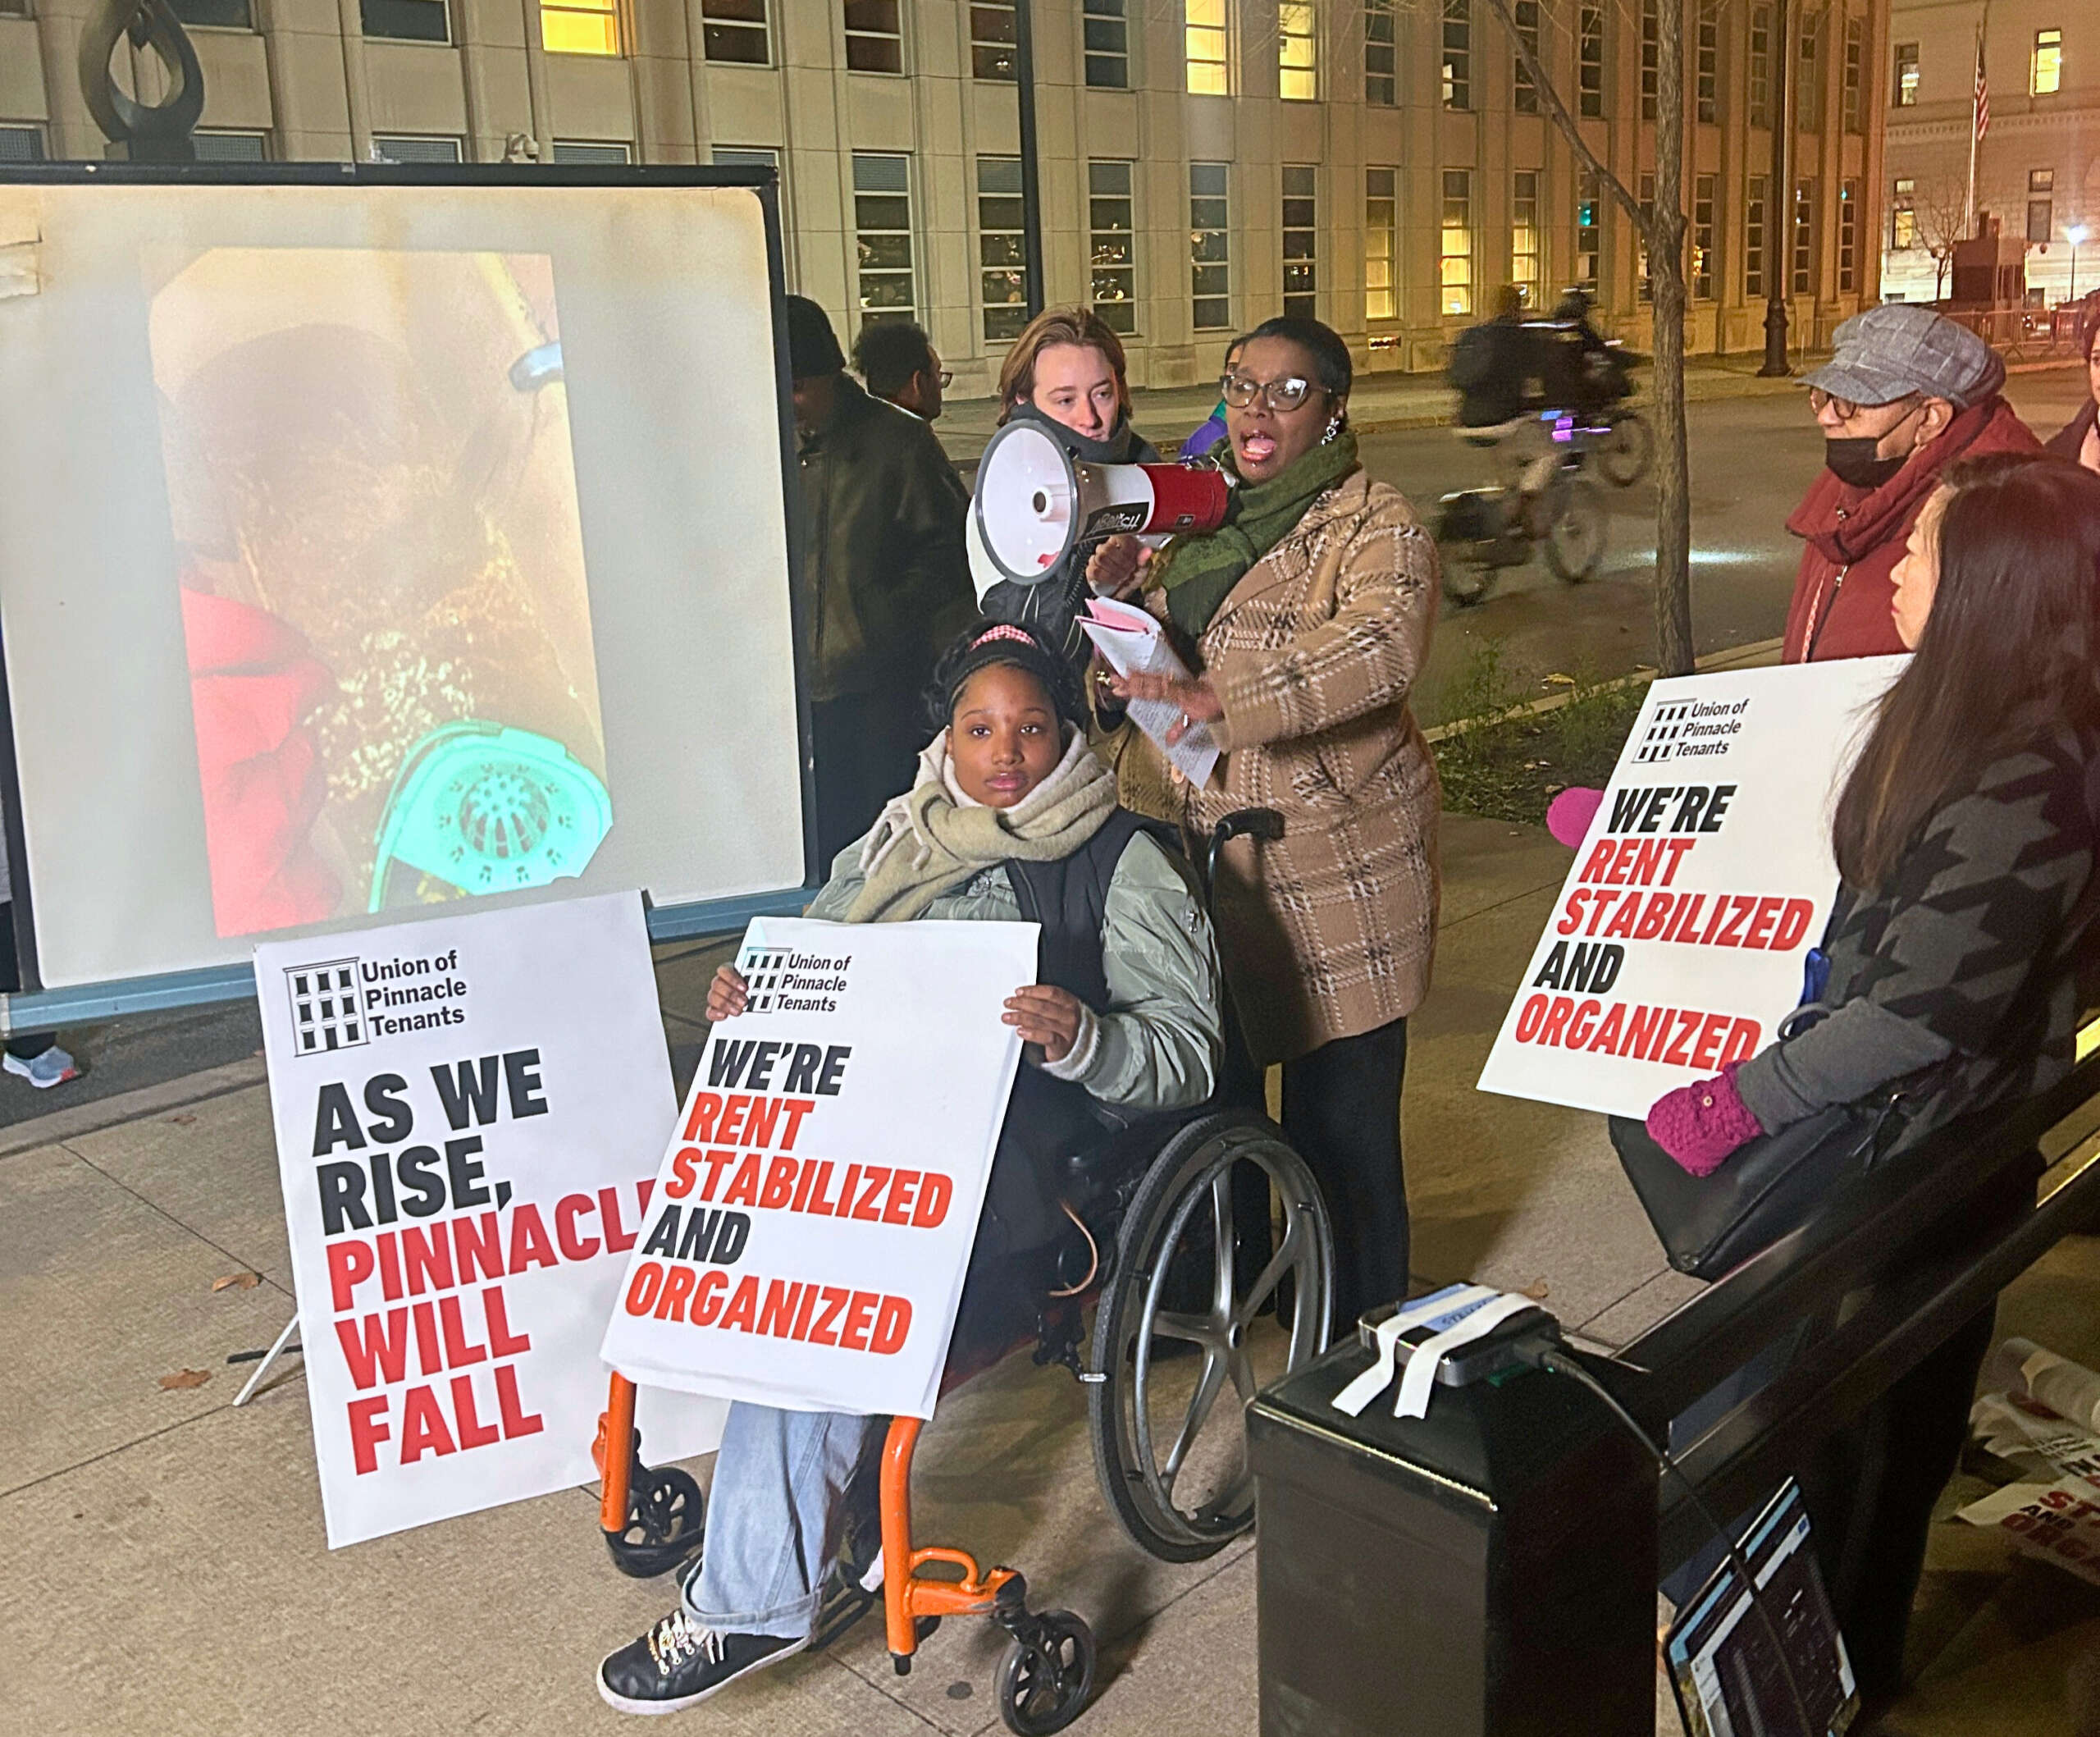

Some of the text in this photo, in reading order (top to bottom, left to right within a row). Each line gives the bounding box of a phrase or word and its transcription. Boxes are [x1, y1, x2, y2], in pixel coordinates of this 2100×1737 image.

[1682, 719, 1741, 737] Pinnacle
[1691, 698, 1749, 717] Union of
[1677, 740, 1728, 757] Tenants
[1608, 785, 1737, 834] WE'RE
[1578, 839, 1695, 886] RENT
[1557, 889, 1813, 951] STABILIZED
[362, 949, 457, 983] Union of
[782, 975, 846, 991] Pinnacle
[789, 953, 851, 971] Union of
[1532, 941, 1624, 994] AND
[366, 978, 466, 1009] Pinnacle
[369, 1006, 464, 1036] Tenants
[777, 994, 836, 1012] Tenants
[1516, 994, 1761, 1072] ORGANIZED
[707, 1039, 851, 1096] WE'RE
[313, 1049, 549, 1157] AS WE
[682, 1092, 815, 1150] RENT
[317, 1136, 513, 1236] RISE,
[665, 1147, 952, 1228] STABILIZED
[326, 1179, 656, 1311] PINNACL
[642, 1204, 751, 1264] AND
[625, 1262, 912, 1355] ORGANIZED
[335, 1286, 530, 1390] WILL
[348, 1364, 543, 1475] FALL
